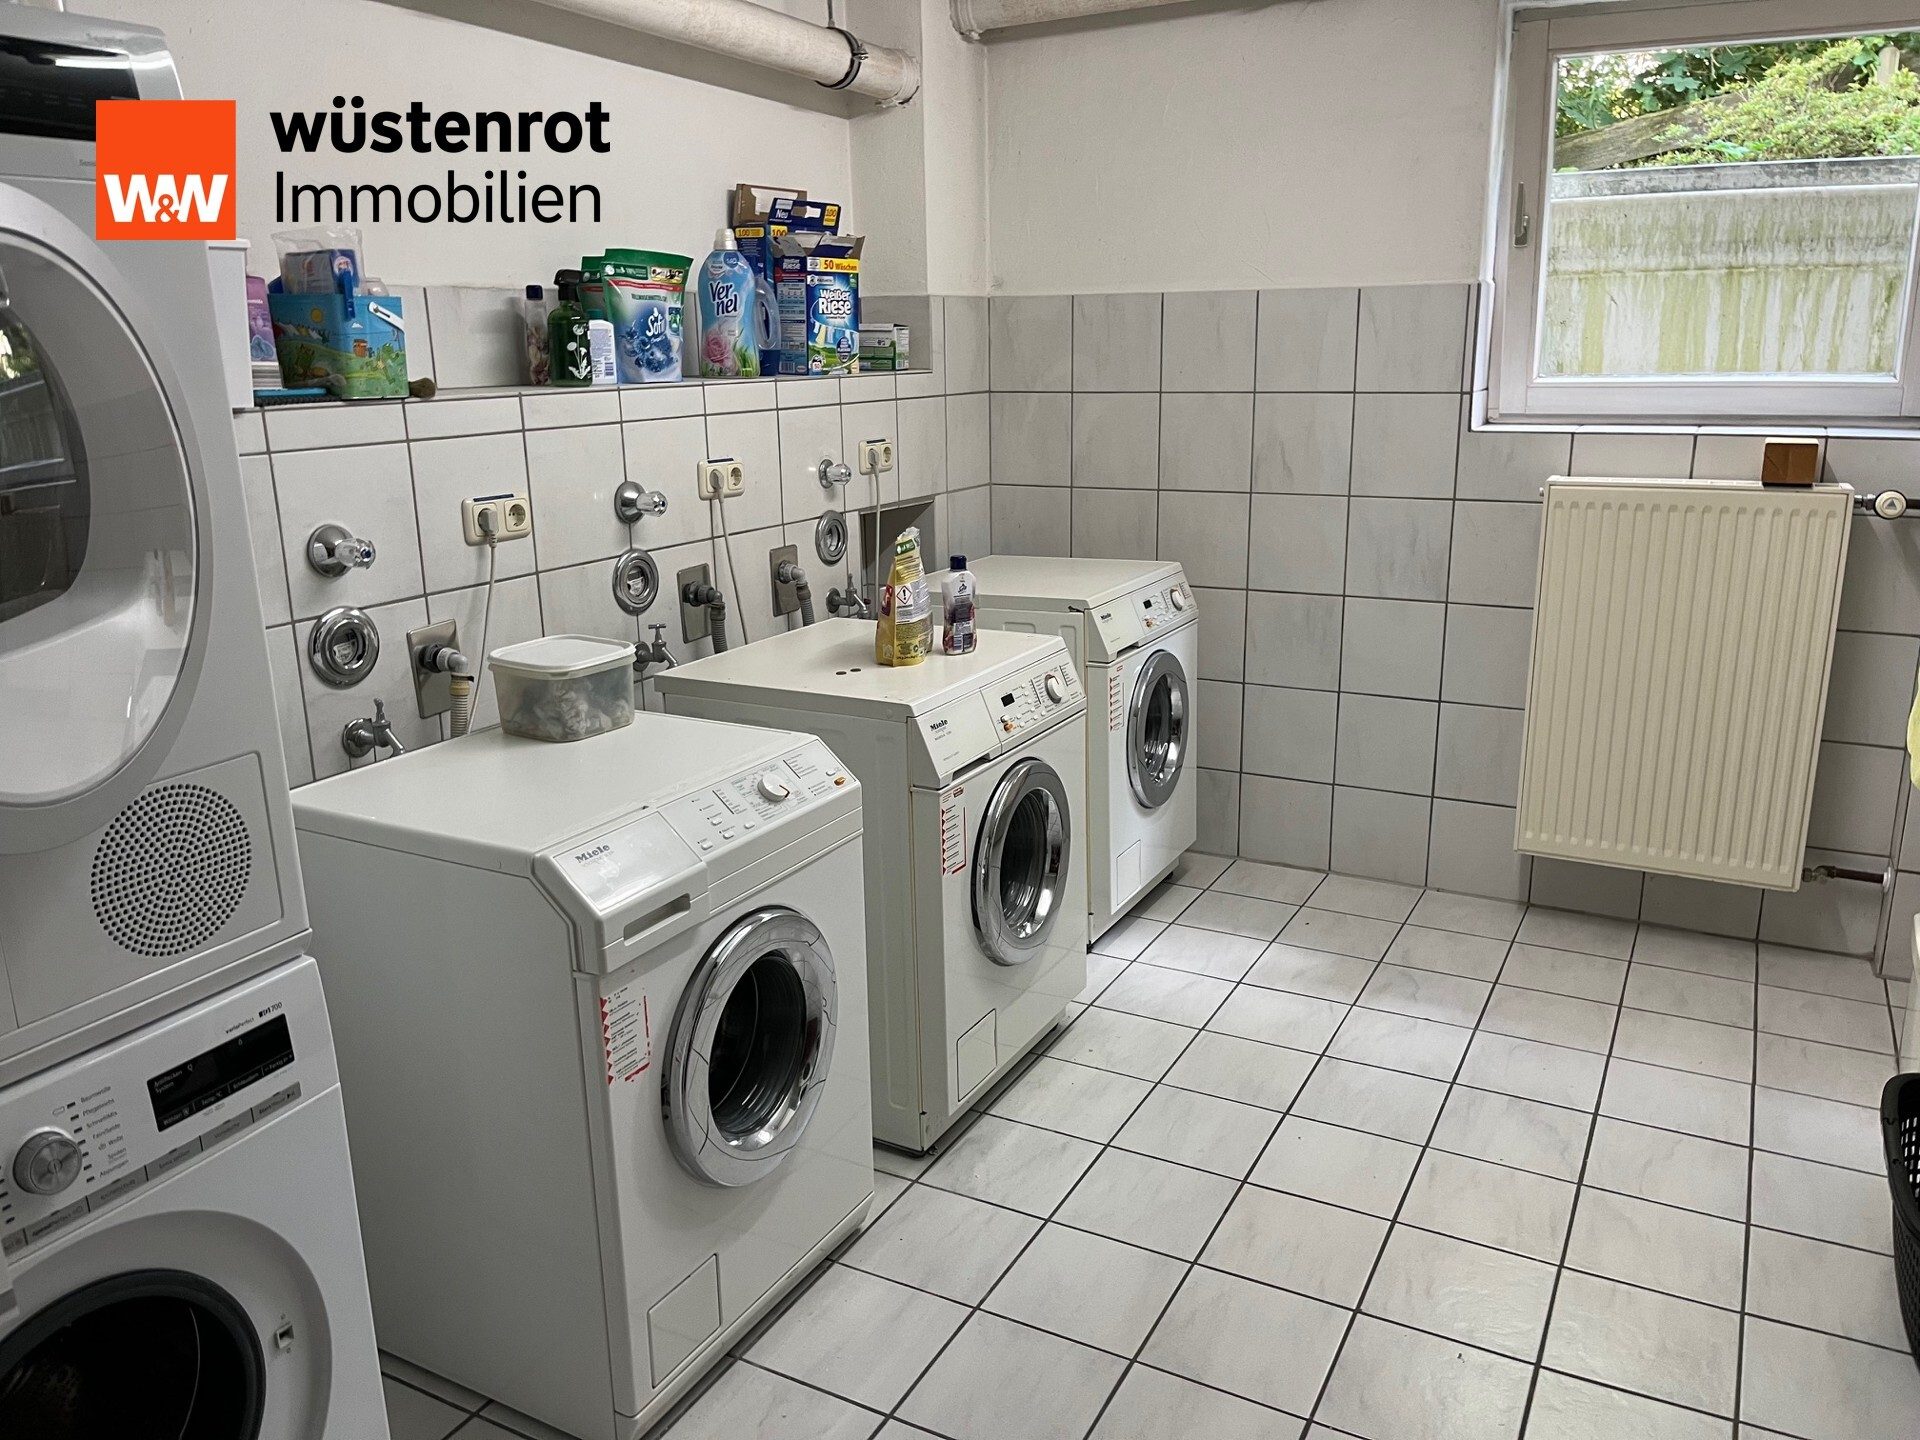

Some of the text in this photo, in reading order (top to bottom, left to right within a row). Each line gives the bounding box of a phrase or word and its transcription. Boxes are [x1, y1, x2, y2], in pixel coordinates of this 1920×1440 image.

[824, 260, 834, 270] 50
[710, 281, 733, 302] Ver
[819, 289, 851, 301] Weißer
[716, 293, 738, 316] nel
[818, 297, 852, 315] Riese
[930, 719, 948, 730] Miele
[575, 844, 610, 864] Miele
